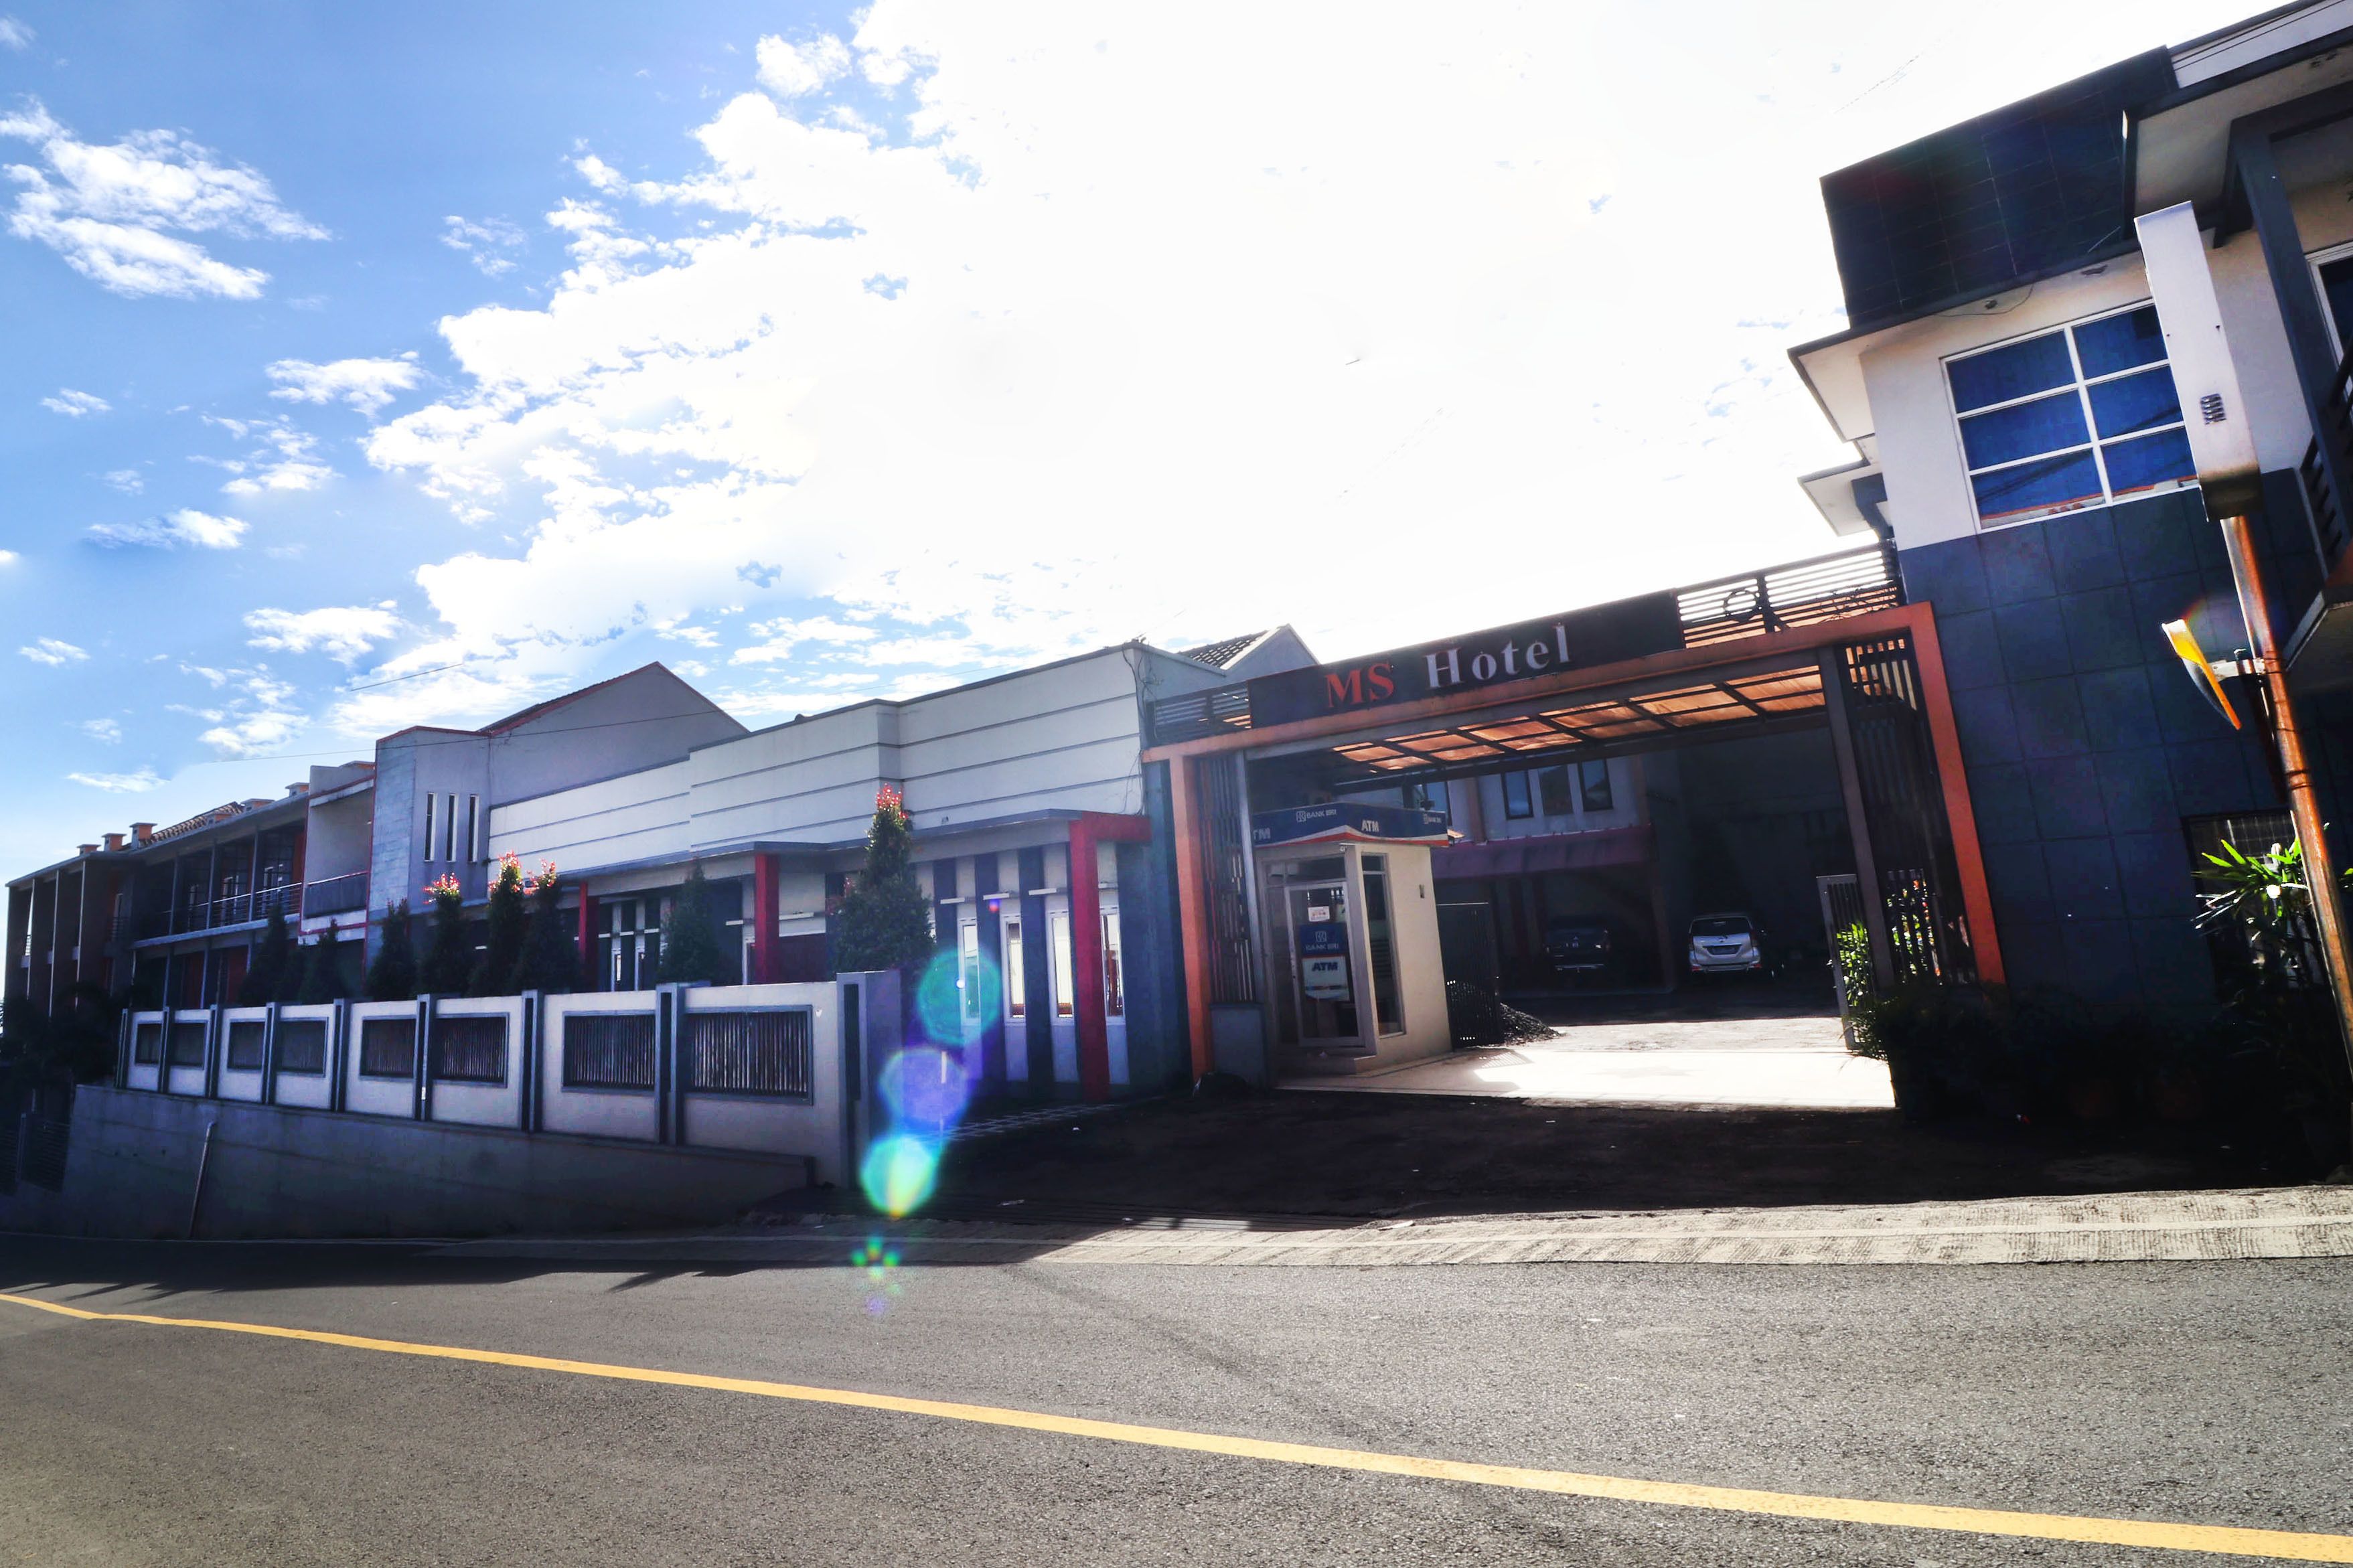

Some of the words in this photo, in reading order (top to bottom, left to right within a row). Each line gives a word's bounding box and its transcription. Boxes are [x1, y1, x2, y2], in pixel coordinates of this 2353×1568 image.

[1325, 661, 1394, 708] MS
[1426, 623, 1570, 688] Hotel
[1306, 811, 1325, 819] BANK
[1361, 819, 1379, 832] ATM
[1254, 828, 1271, 840] TM
[1312, 961, 1339, 971] ATM
